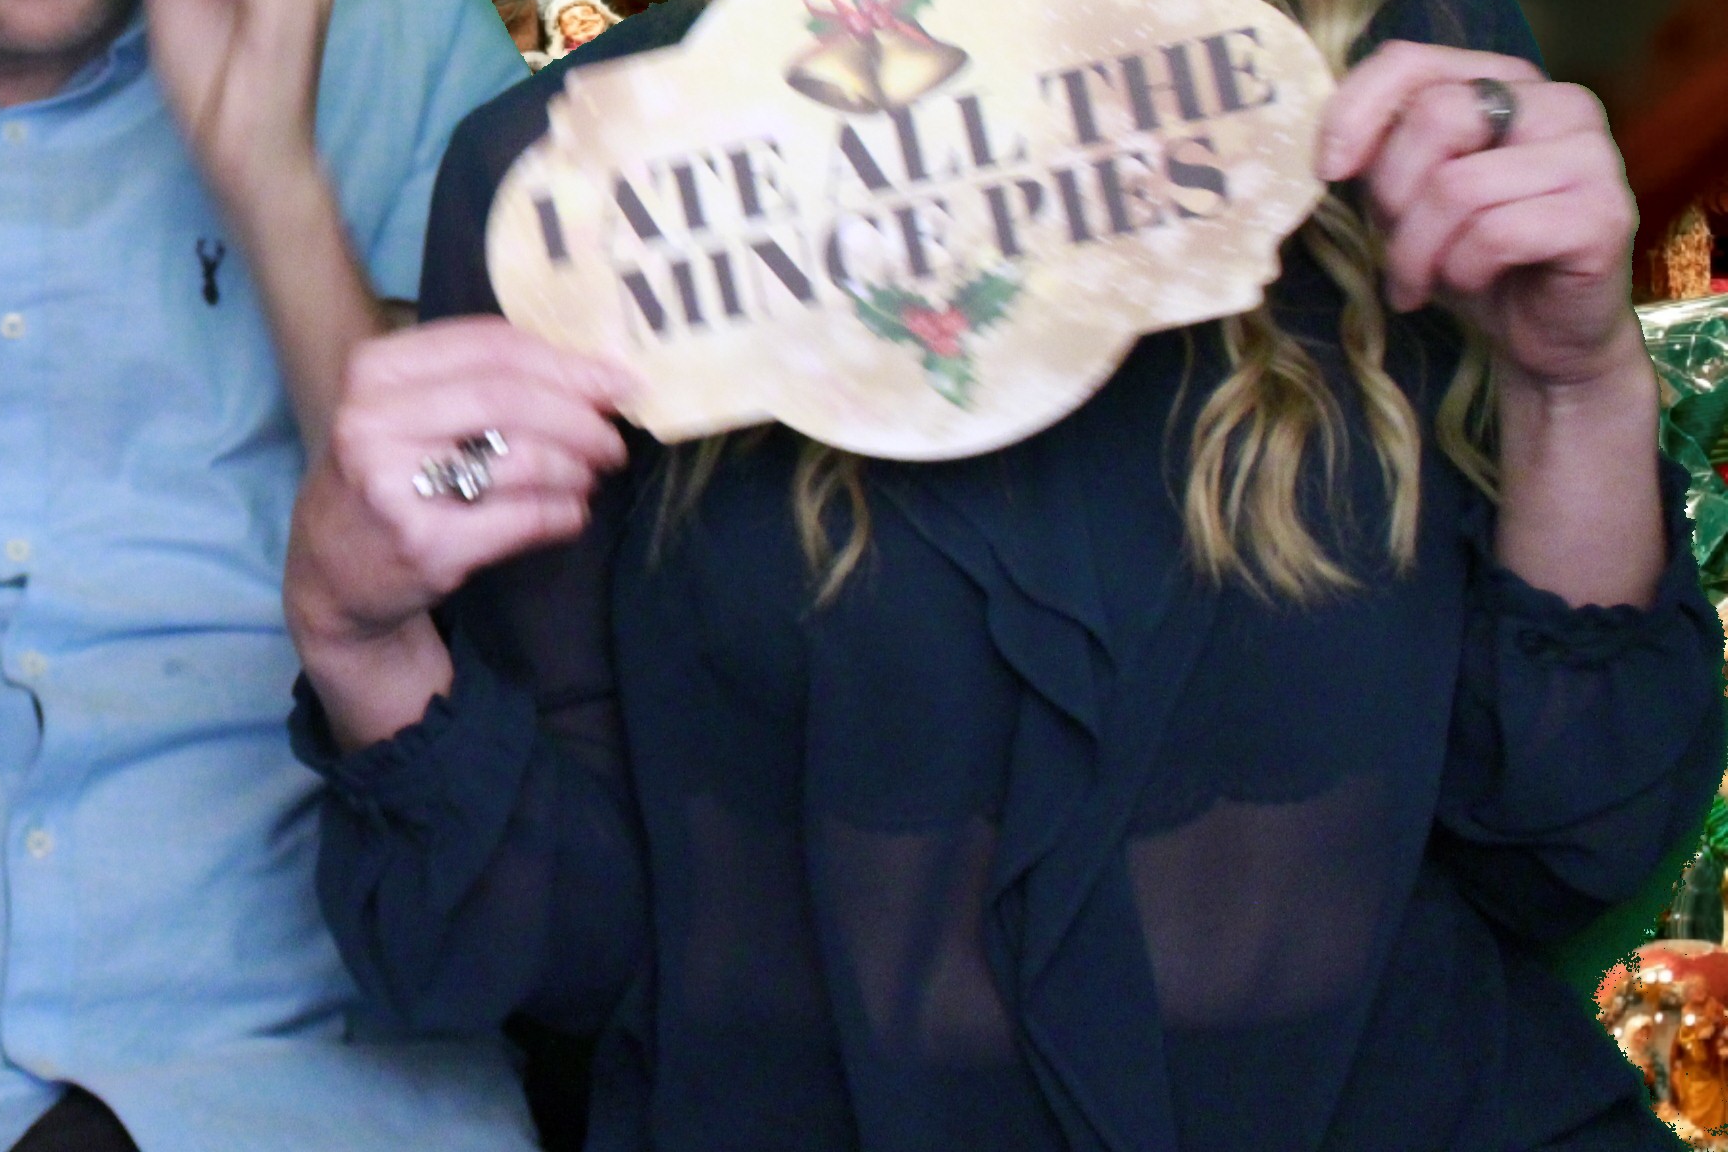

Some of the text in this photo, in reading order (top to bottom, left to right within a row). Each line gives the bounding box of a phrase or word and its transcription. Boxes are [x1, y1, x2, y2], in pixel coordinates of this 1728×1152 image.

[527, 25, 1280, 267] I ATE ALL THE
[616, 134, 1232, 344] MINCE PIES
